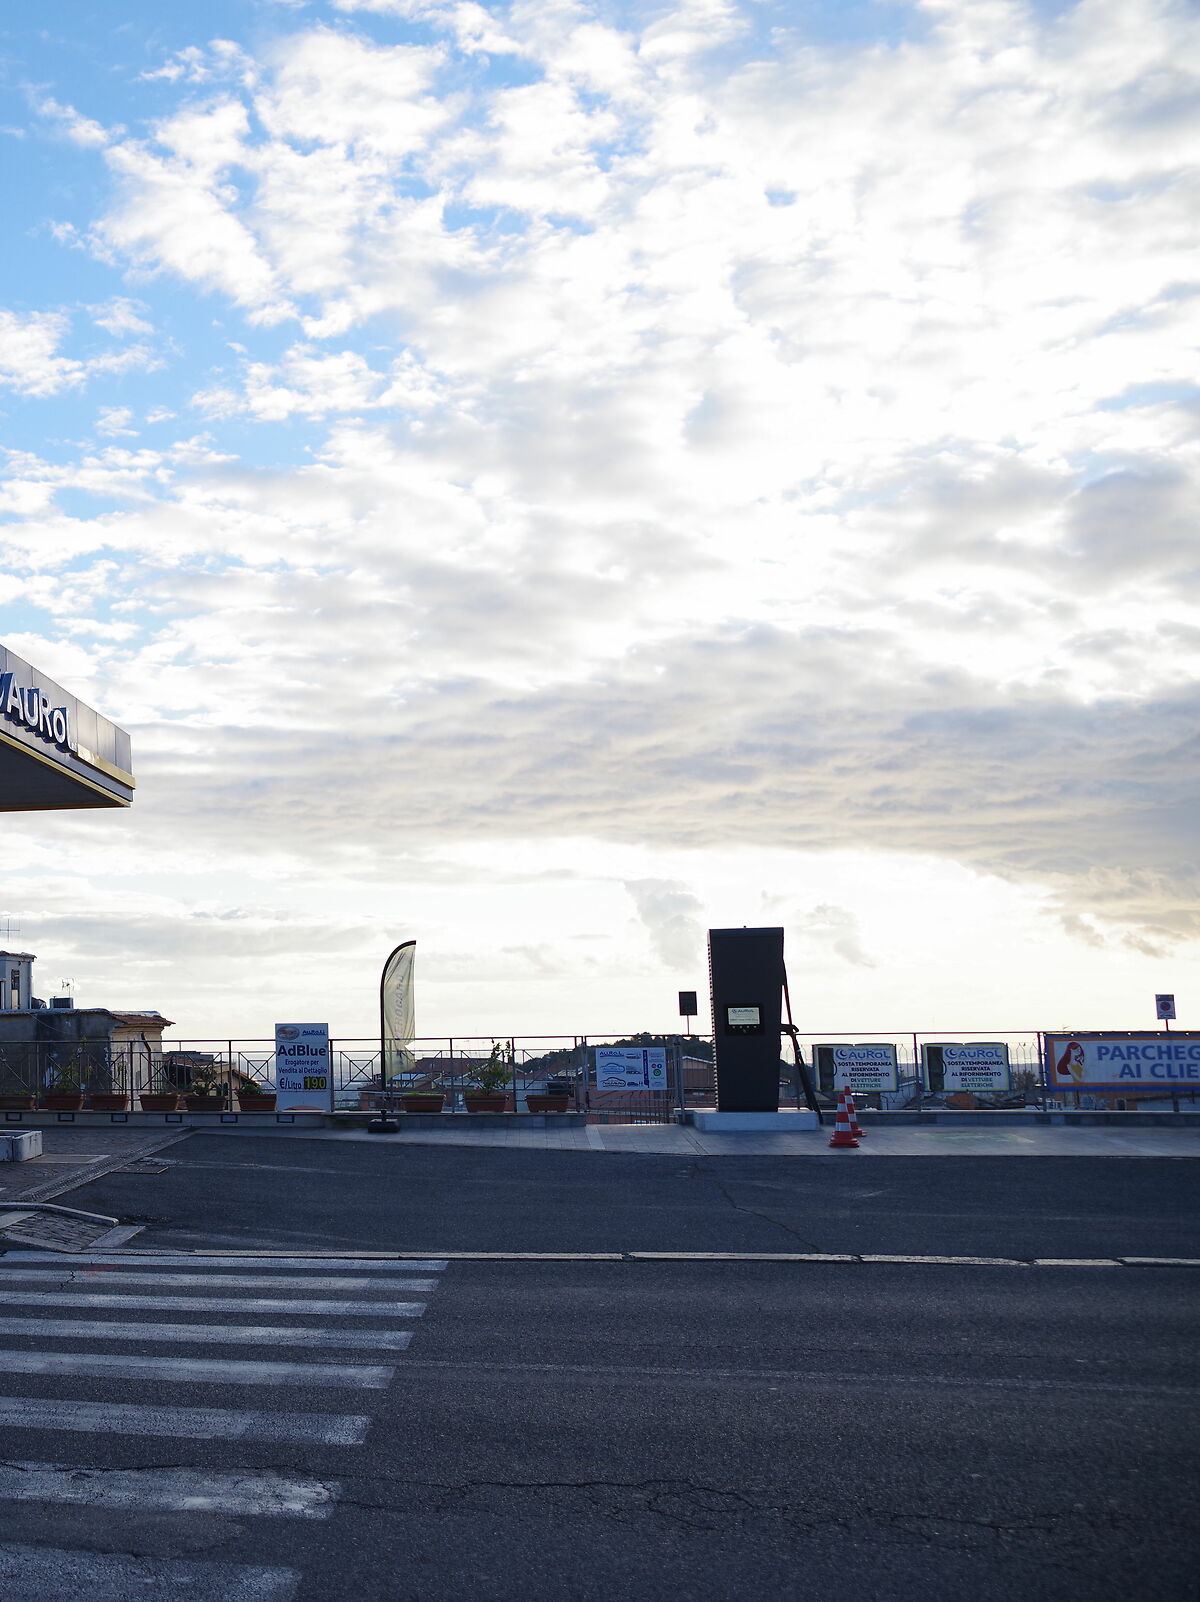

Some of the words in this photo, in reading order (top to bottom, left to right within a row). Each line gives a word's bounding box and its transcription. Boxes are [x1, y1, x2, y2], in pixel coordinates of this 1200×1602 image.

[277, 1045, 326, 1056] AdBlue
[1097, 1045, 1200, 1061] PARCHEG
[1119, 1064, 1141, 1078] AI
[1150, 1063, 1199, 1078] CLIE
[304, 1078, 326, 1089] 190
